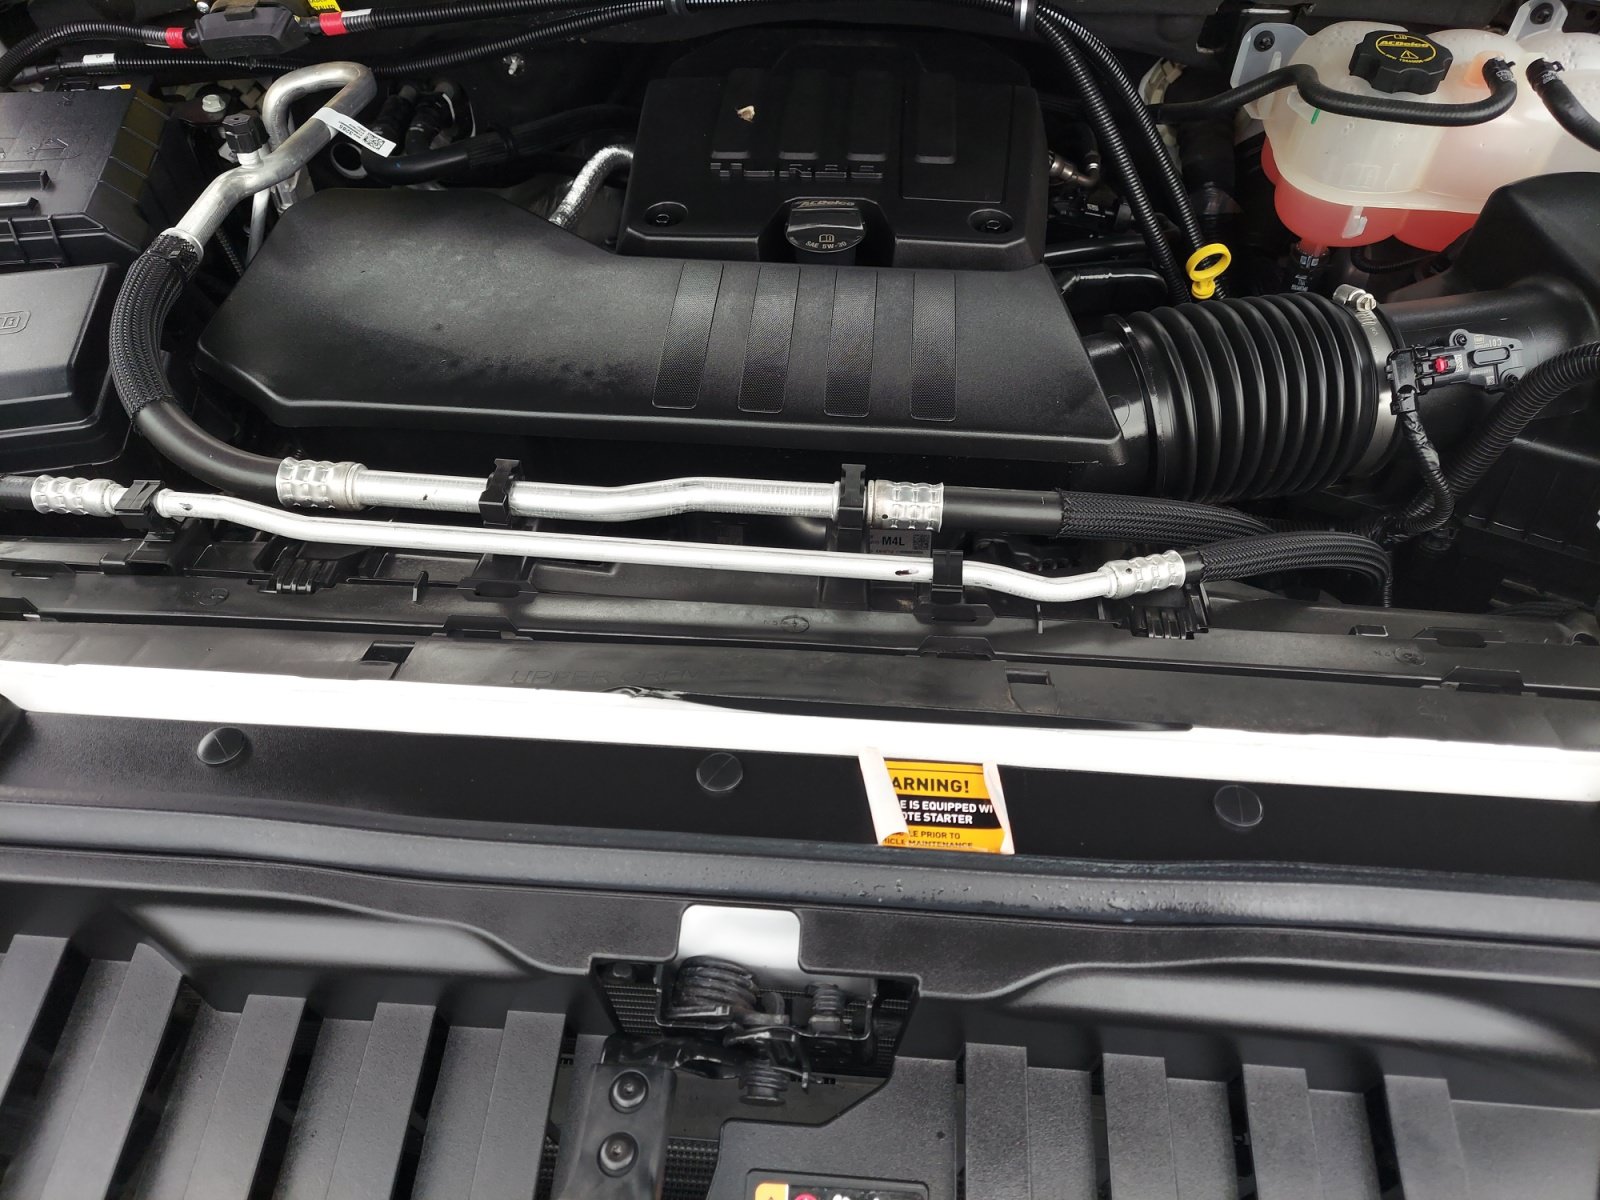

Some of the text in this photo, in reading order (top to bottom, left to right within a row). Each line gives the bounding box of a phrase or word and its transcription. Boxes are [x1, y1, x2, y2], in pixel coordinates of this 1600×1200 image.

[1378, 40, 1429, 48] ACDelco
[805, 240, 820, 249] SAE
[882, 536, 905, 546] M4L
[892, 776, 969, 793] ARNING!
[909, 800, 920, 810] IS
[922, 801, 977, 813] EQUIPPED
[978, 804, 993, 814] WI
[903, 812, 973, 825] OTE STARTER
[920, 831, 947, 839] PRIOR
[949, 832, 961, 840] TO
